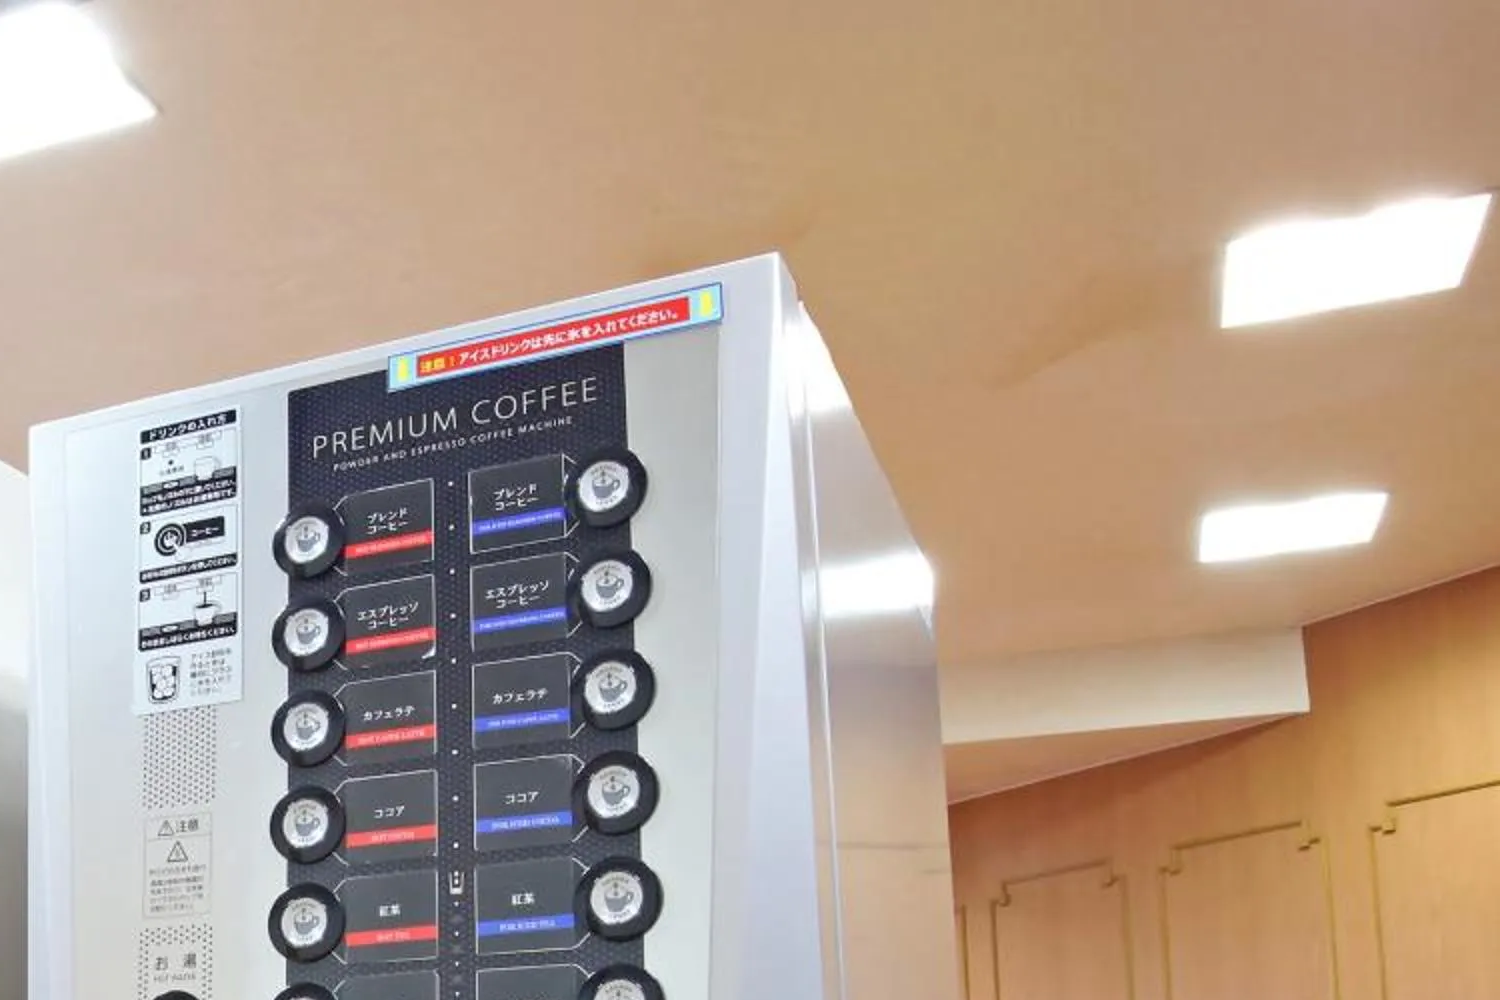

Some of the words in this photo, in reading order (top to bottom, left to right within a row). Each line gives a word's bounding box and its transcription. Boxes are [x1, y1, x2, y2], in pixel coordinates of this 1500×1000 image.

[149, 414, 227, 440] ドリンクの入れ方
[312, 407, 458, 459] PREMIUM
[471, 377, 598, 425] COFFEE
[333, 454, 379, 473] POWDER
[383, 449, 406, 463] AND
[410, 438, 467, 457] ESPRESSO
[469, 427, 513, 446] COFFEE
[518, 416, 573, 434] MACHINE
[492, 483, 538, 501] ブレンド
[494, 495, 540, 511] コーヒー
[366, 507, 409, 525] ブレンド
[366, 520, 409, 535] コーヒー
[485, 579, 550, 600] エスプレッソ
[495, 594, 540, 609] コーヒー
[356, 601, 419, 622] エスプレッソ
[366, 616, 409, 631] コーヒー
[492, 687, 549, 706] カフェラテ
[362, 705, 418, 722] カフェラテ
[504, 791, 540, 805] ココア
[373, 805, 406, 819] ココア
